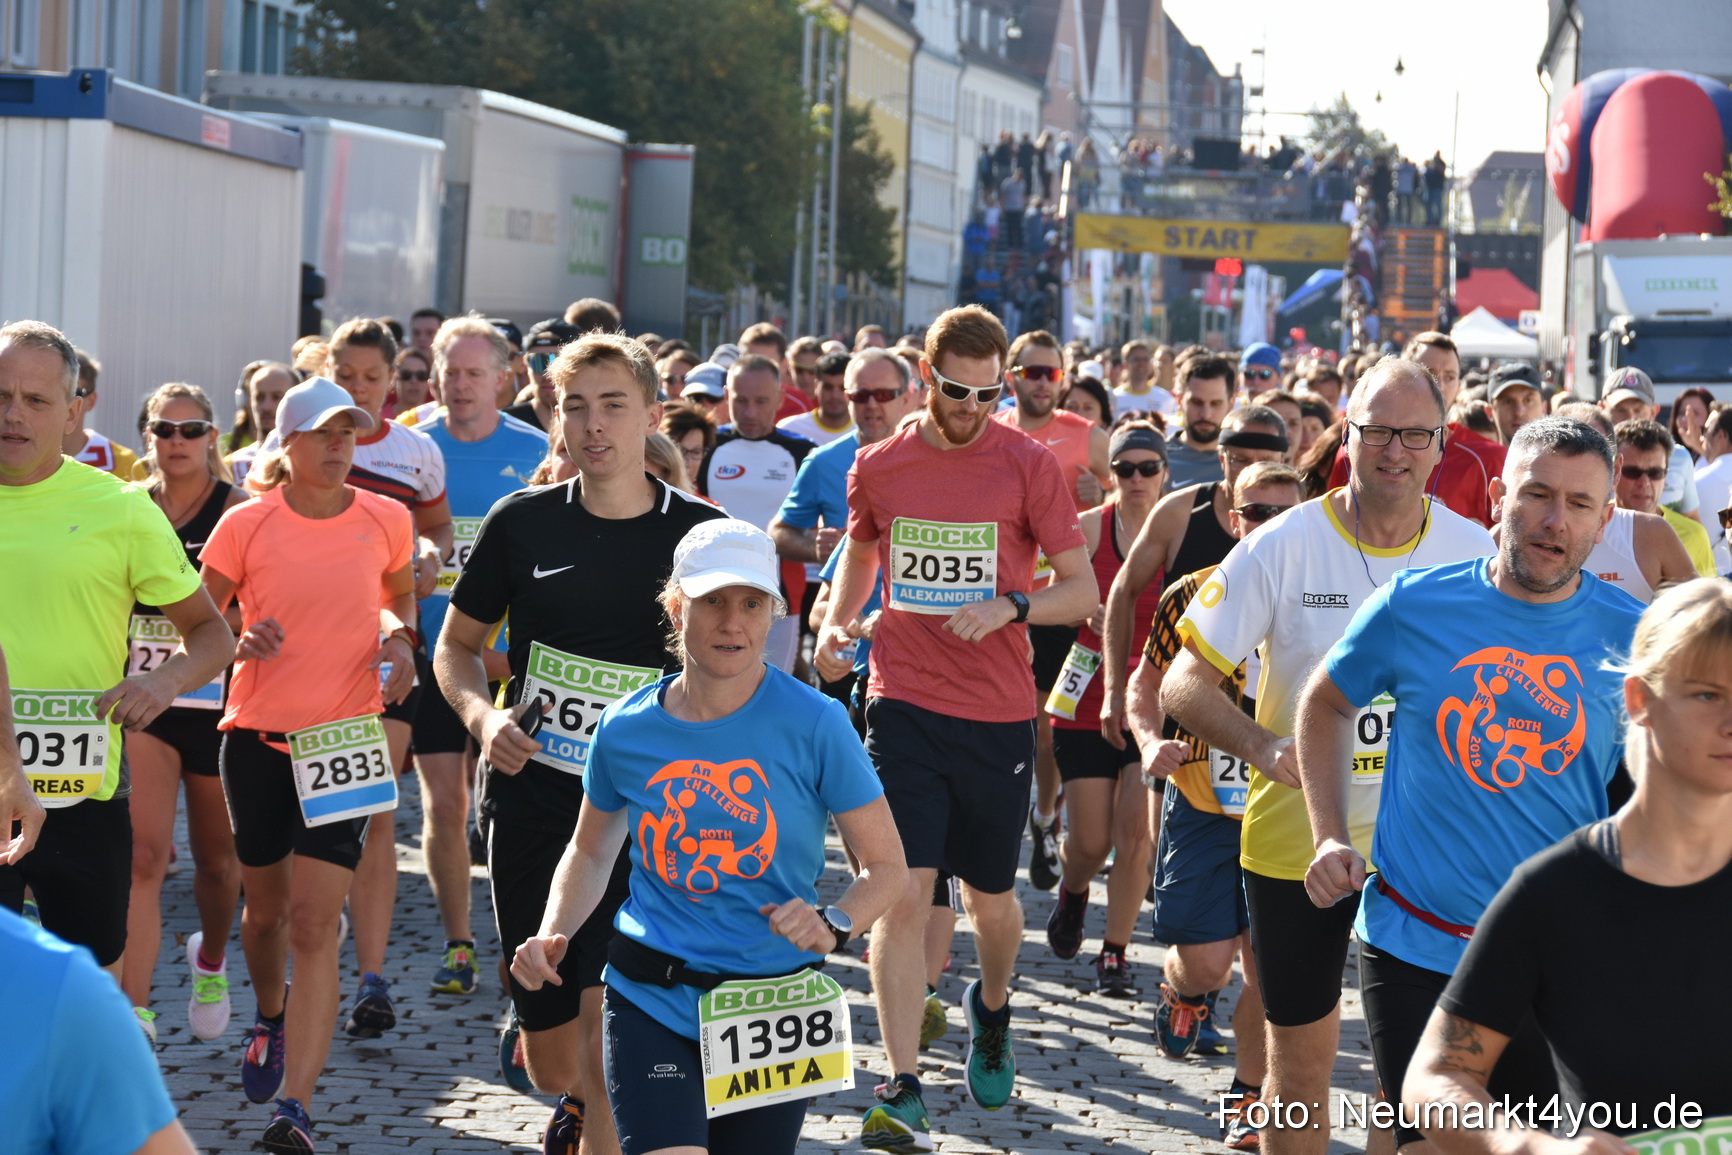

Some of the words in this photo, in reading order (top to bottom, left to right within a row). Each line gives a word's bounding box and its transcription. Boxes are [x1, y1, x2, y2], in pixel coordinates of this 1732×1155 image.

[1165, 226, 1259, 250] START
[641, 237, 687, 264] BO
[718, 465, 737, 474] tkn
[900, 524, 984, 546] BOCK
[902, 552, 984, 583] 2035
[900, 587, 985, 602] ALEXANDER
[1303, 593, 1348, 605] BOCK
[1503, 652, 1525, 667] An
[540, 654, 644, 693] BOCK
[1474, 692, 1491, 706] Mi
[1496, 665, 1569, 719] CHALLENGE
[1507, 717, 1542, 732] ROTH
[300, 721, 380, 752] BOCK
[1470, 736, 1482, 767] 2019
[1557, 739, 1575, 757] Ka
[307, 749, 385, 791] 2833
[691, 763, 711, 777] An
[1352, 756, 1387, 771] STE
[30, 779, 85, 794] REAS
[684, 777, 758, 824] CHALLENGE
[665, 807, 681, 820] Mi
[699, 829, 733, 840] ROTH
[751, 844, 769, 862] Ka
[666, 850, 679, 880] 2019
[714, 974, 829, 1012] BOCK
[720, 1010, 833, 1064] 1398
[726, 1057, 824, 1099] ANITA
